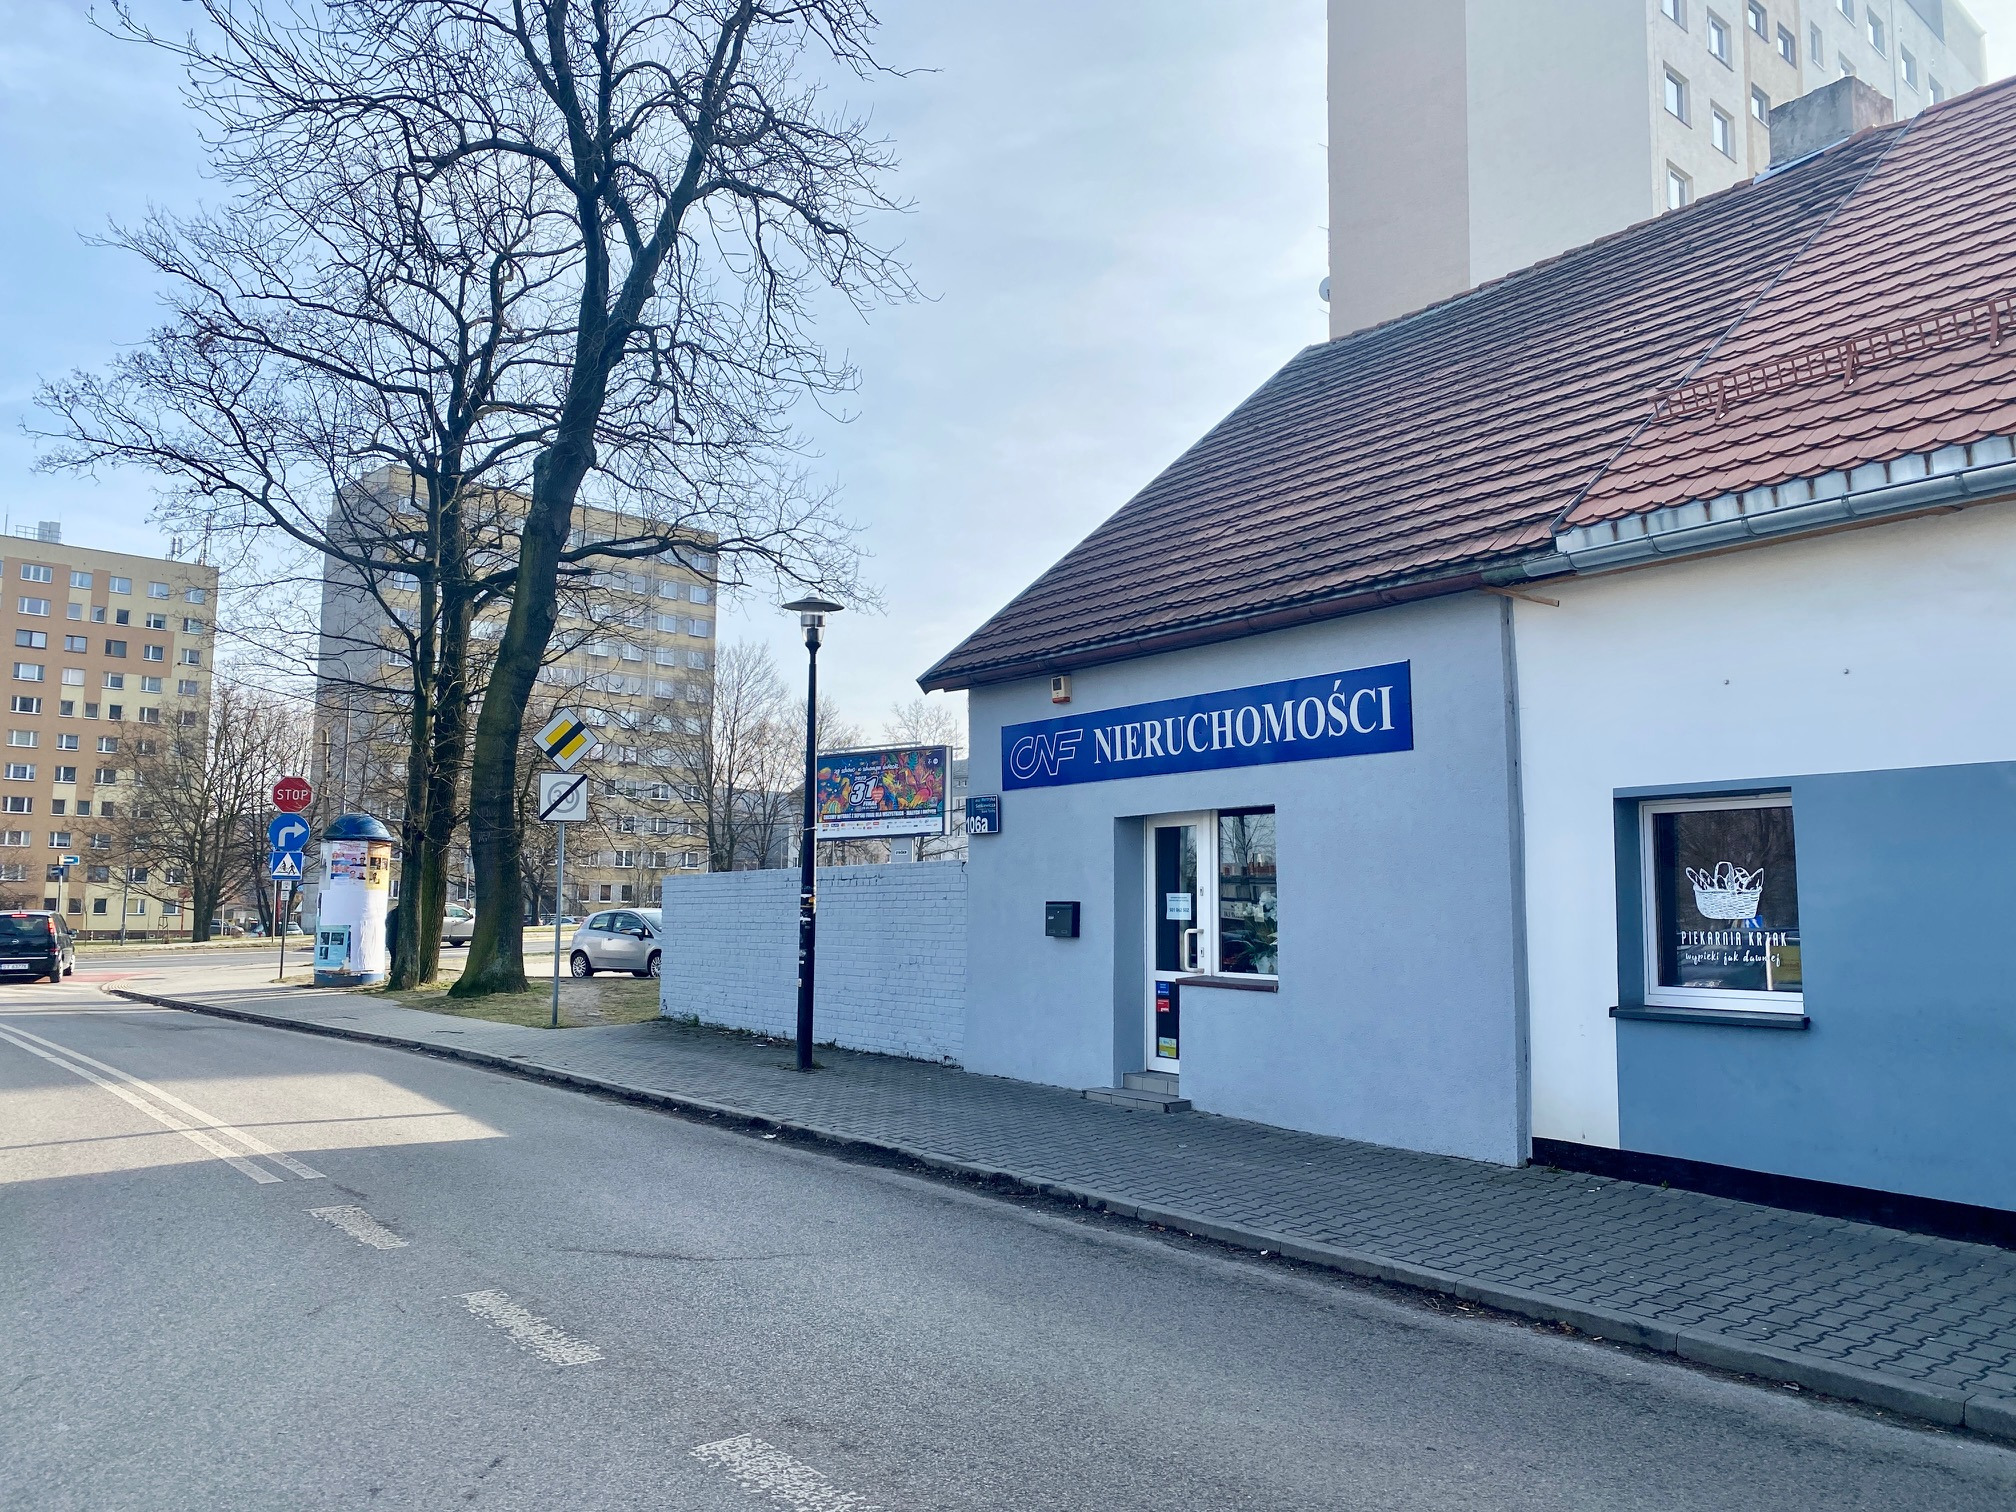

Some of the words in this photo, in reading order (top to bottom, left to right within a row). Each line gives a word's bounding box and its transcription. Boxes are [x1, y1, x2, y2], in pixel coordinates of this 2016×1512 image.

[1093, 680, 1395, 764] NIERUCHOMOŚCI
[277, 789, 309, 801] STOP
[850, 776, 877, 805] 31
[966, 816, 988, 833] 106a
[1681, 931, 1742, 946] PIEKARNIA
[1749, 931, 1787, 947] KRZAK
[1685, 951, 1719, 965] wypieki
[1722, 952, 1739, 966] jak
[1743, 949, 1781, 967] dawnej
